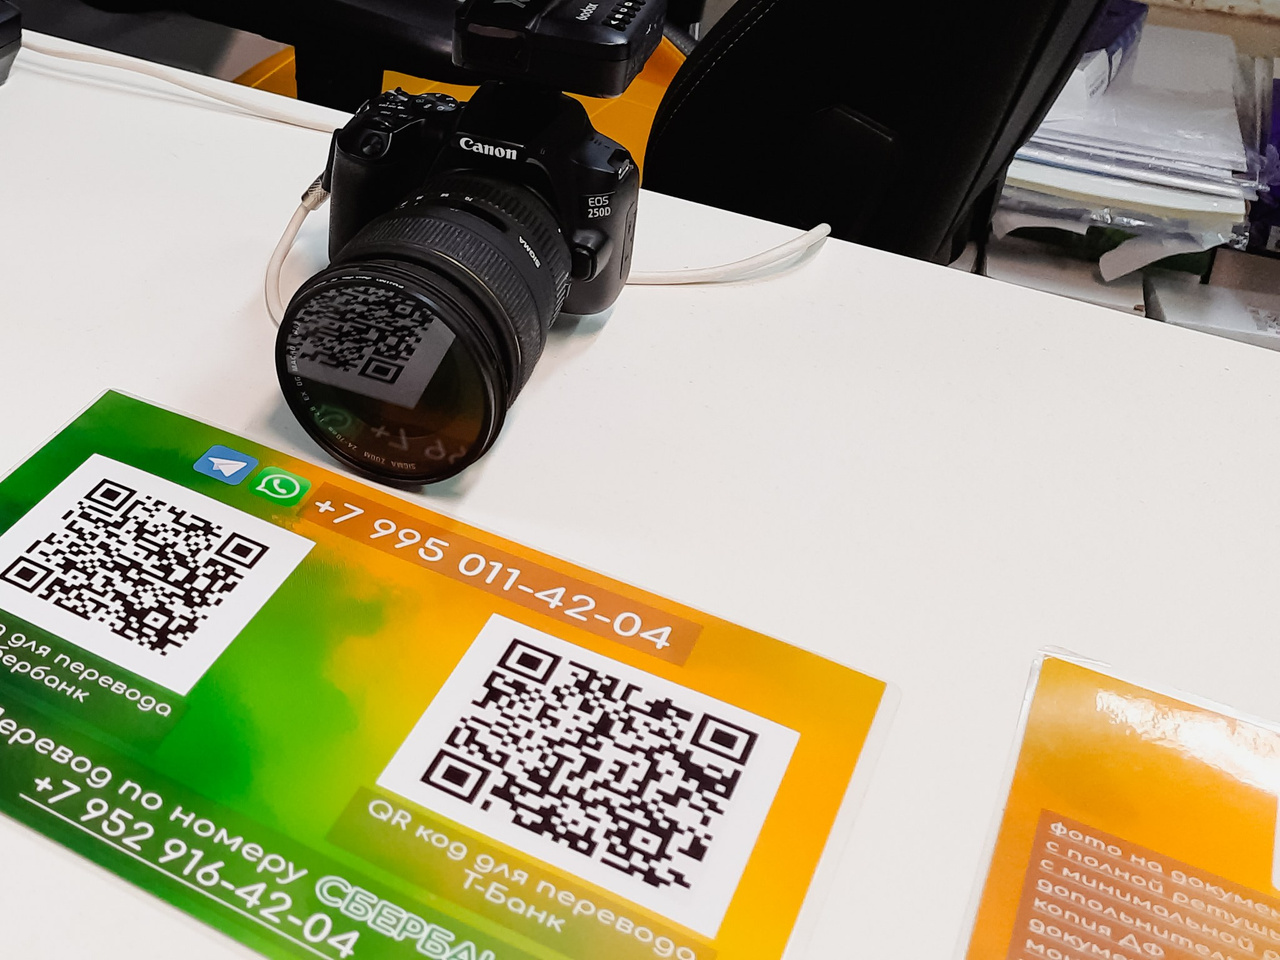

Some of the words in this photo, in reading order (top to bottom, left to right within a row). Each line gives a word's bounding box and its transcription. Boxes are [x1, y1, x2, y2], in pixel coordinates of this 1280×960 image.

[459, 137, 518, 161] Canon
[587, 206, 612, 219] 250D
[588, 195, 610, 207] EOS
[519, 235, 542, 269] SIGMA
[294, 375, 303, 388] DG
[300, 390, 310, 402] EX
[363, 451, 386, 465] ZOOM
[391, 460, 417, 471] SIGMA
[314, 499, 365, 524] +7
[369, 518, 450, 562] 995
[457, 553, 673, 650] 011-42-04
[7, 632, 52, 658] для
[53, 652, 173, 718] перевода
[33, 775, 82, 805] +7
[80, 797, 155, 852] 952
[158, 837, 361, 959] 916-42-04
[117, 778, 164, 811] по
[168, 805, 309, 885] номеру
[314, 873, 496, 960] СБЕРБА
[1045, 840, 1060, 853] с
[1067, 848, 1164, 894] полной
[1049, 821, 1123, 857] фото
[1130, 853, 1163, 873] на
[368, 798, 413, 832] QR
[415, 824, 468, 861] код
[473, 853, 530, 885] для
[536, 879, 697, 960] перевода
[463, 868, 567, 933] Т-Банк
[1033, 896, 1112, 937] копия
[1040, 858, 1055, 871] с
[1062, 866, 1255, 953] минимальной
